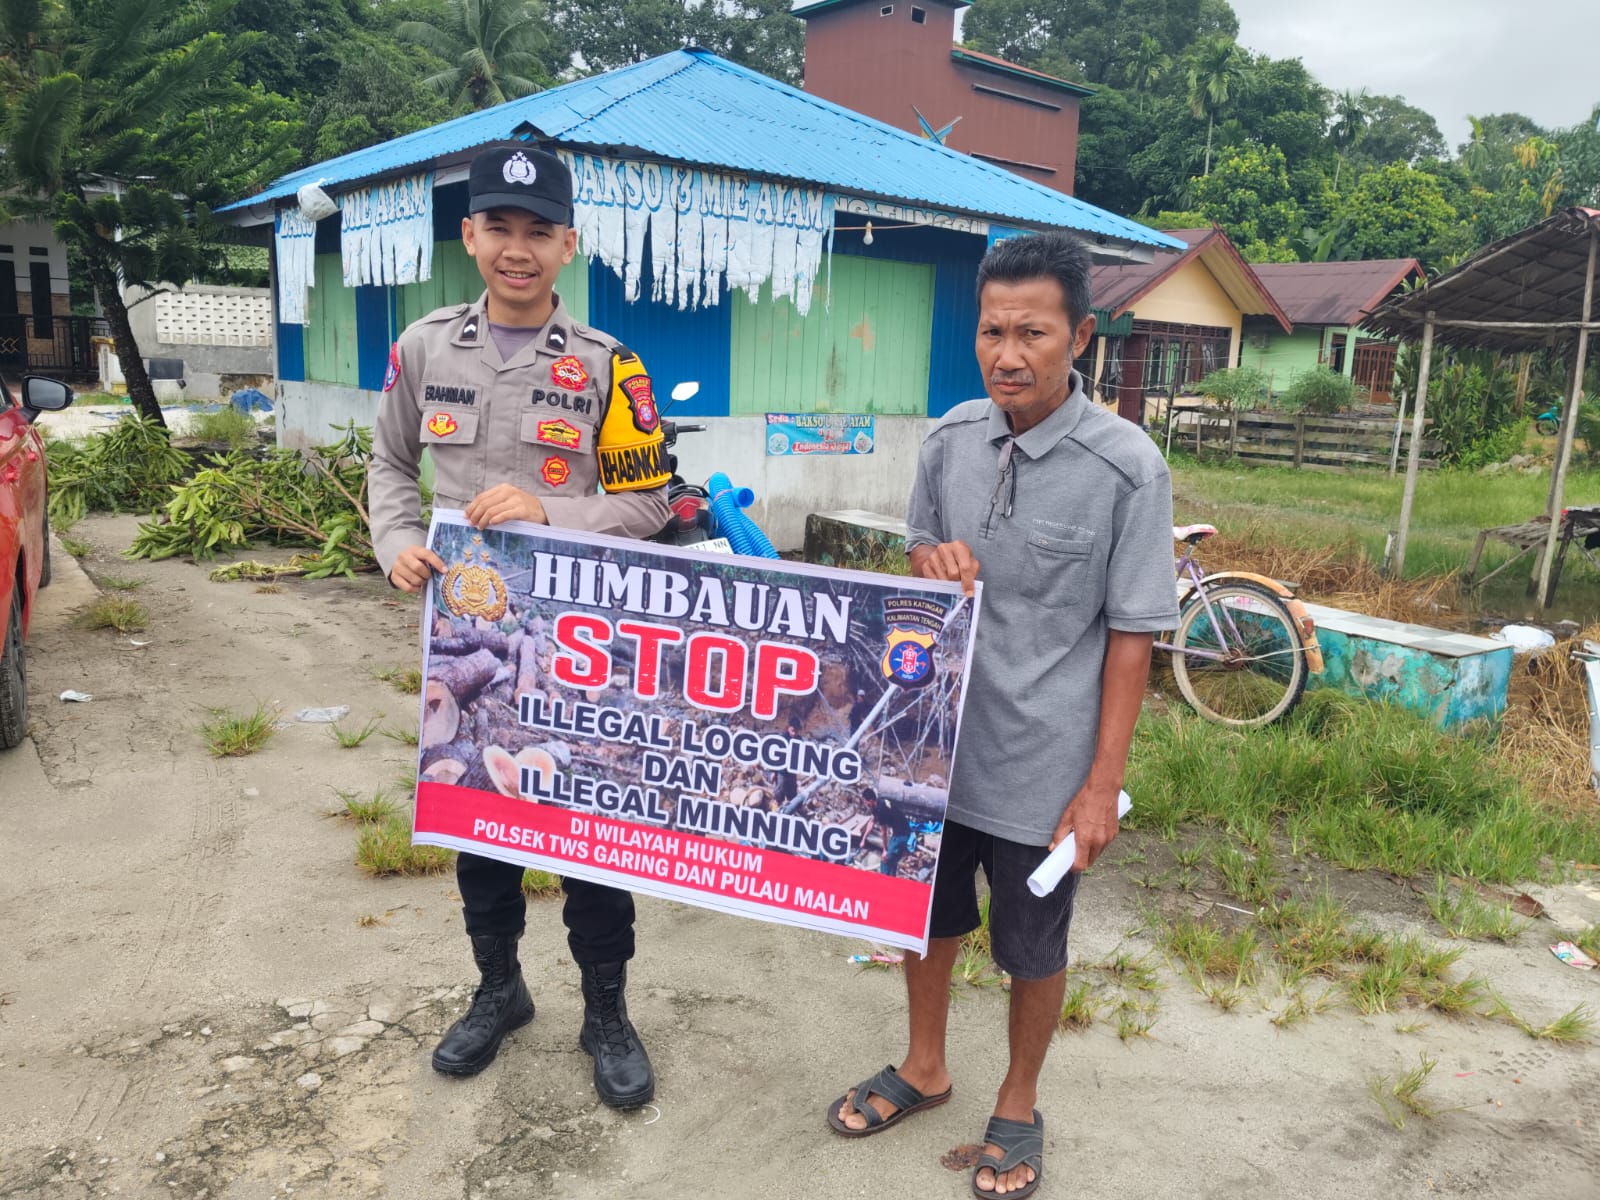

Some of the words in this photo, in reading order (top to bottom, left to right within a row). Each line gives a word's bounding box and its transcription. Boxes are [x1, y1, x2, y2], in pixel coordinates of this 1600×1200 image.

[342, 188, 371, 232] MIE
[376, 173, 426, 227] AYAM
[699, 169, 749, 221] MIE
[755, 182, 825, 232] AYAM
[532, 389, 592, 415] POLRI
[796, 416, 823, 428] BAKSO
[850, 416, 871, 428] AYAM
[531, 551, 852, 643] HIMBAUAN
[887, 613, 919, 622] KALIMANTAN
[921, 617, 941, 630] TENGAH
[914, 601, 945, 615] KATINGAN
[554, 614, 817, 717] STOP
[520, 696, 671, 747] ILLEGAL
[683, 723, 859, 780] LOGGING
[644, 755, 720, 793] DAN
[520, 768, 667, 821] ILLEGAL
[679, 800, 848, 855] MINNING
[473, 818, 544, 850] POLSEK
[549, 834, 589, 859] TWS
[594, 846, 669, 878] GARING
[674, 861, 716, 887] DAN
[720, 872, 789, 903] PULAU
[794, 887, 869, 920] MALAN
[571, 817, 590, 837] DI
[595, 822, 679, 855] WILAYAH
[685, 841, 763, 873] HUKUM
